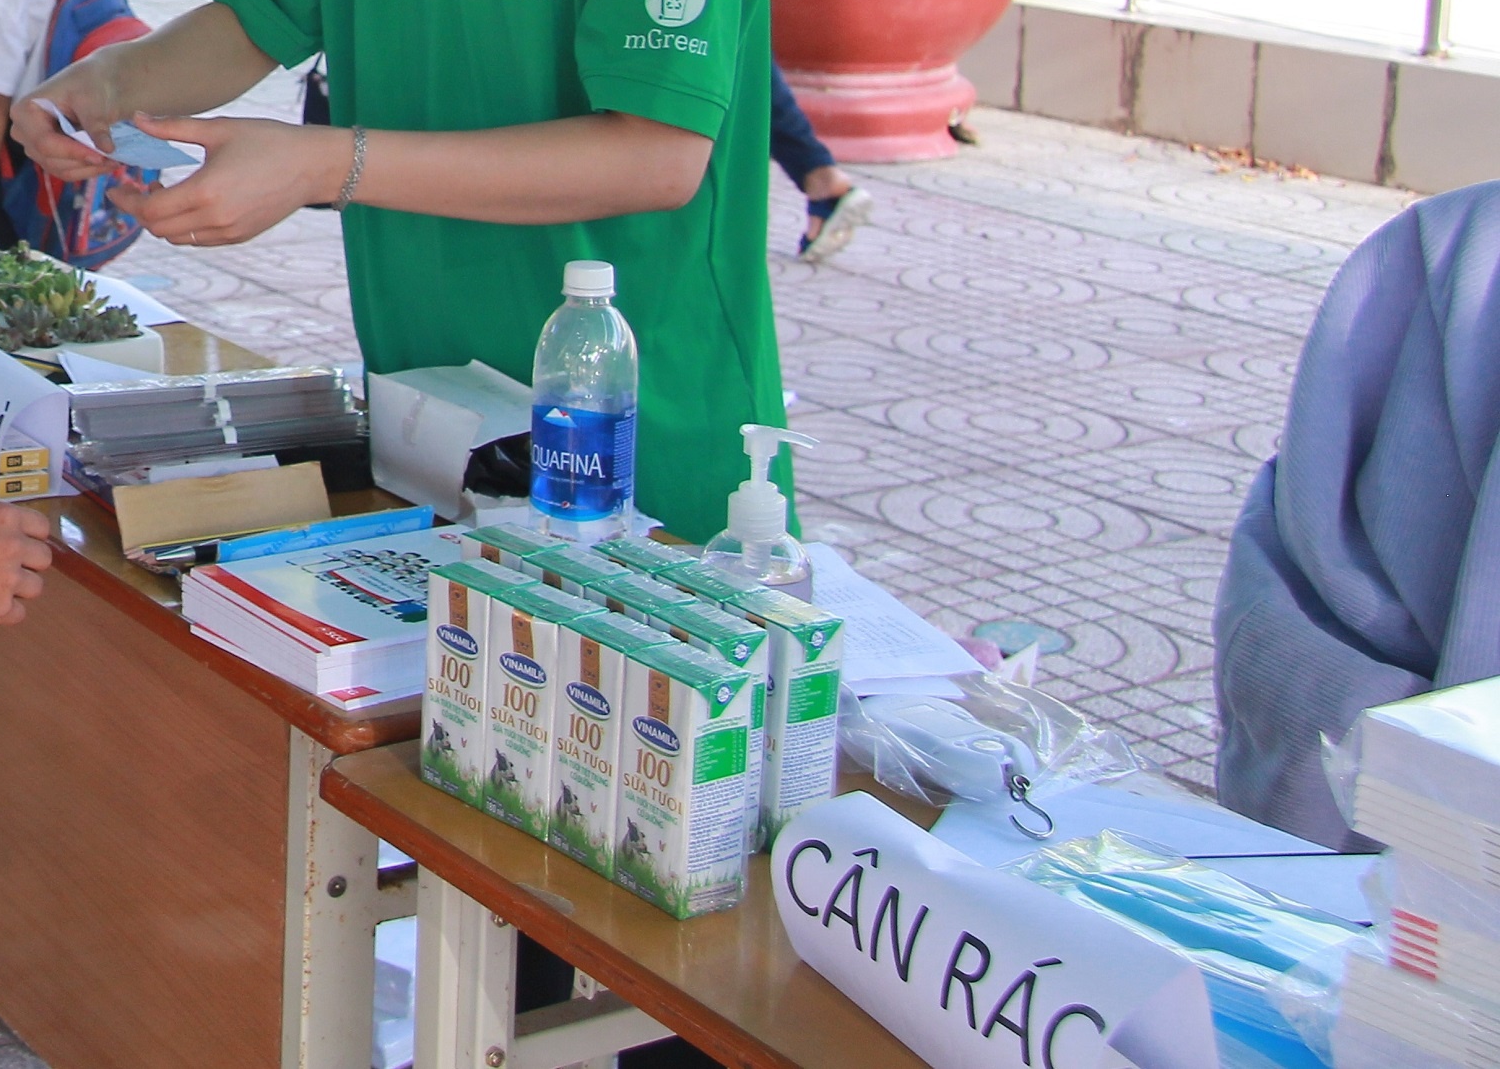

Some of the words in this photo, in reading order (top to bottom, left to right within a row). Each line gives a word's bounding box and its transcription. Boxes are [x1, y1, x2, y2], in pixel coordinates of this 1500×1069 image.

[623, 28, 708, 56] mGreen
[532, 443, 606, 479] QUAFINA
[438, 627, 477, 653] VINAMILK
[502, 655, 546, 682] VINAMILK
[569, 686, 609, 714] VINAMILK
[636, 720, 679, 749] VINAMILK
[785, 838, 929, 983] CÂN
[940, 930, 1106, 1069] RÁC
